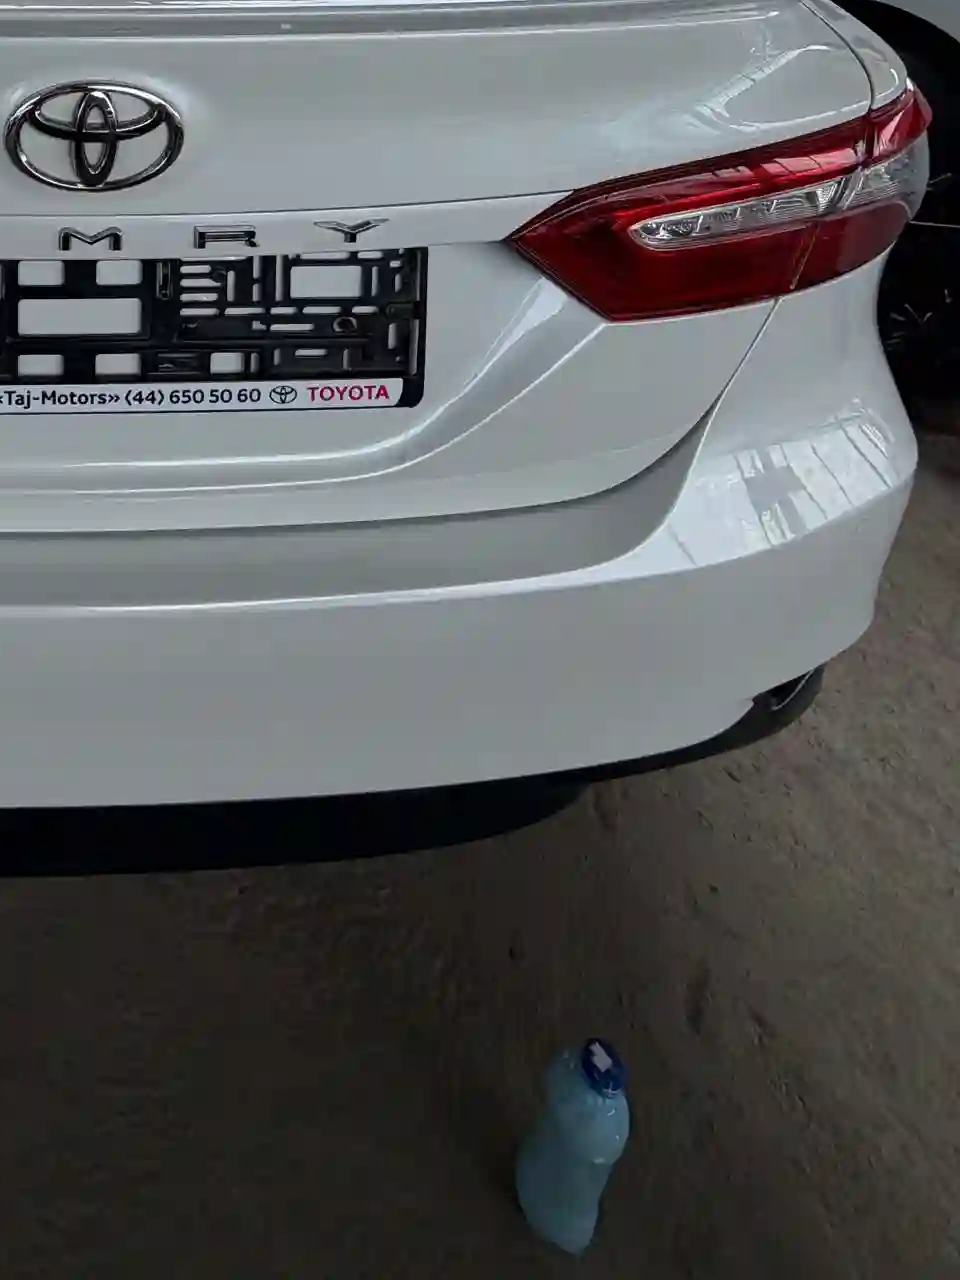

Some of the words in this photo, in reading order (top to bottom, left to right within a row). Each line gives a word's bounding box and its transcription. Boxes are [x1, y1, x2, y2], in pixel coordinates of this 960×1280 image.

[124, 388, 165, 407] (44)
[169, 389, 205, 405] 650
[209, 388, 233, 404] 50
[236, 387, 261, 403] 60
[307, 384, 390, 402] TOYOTA
